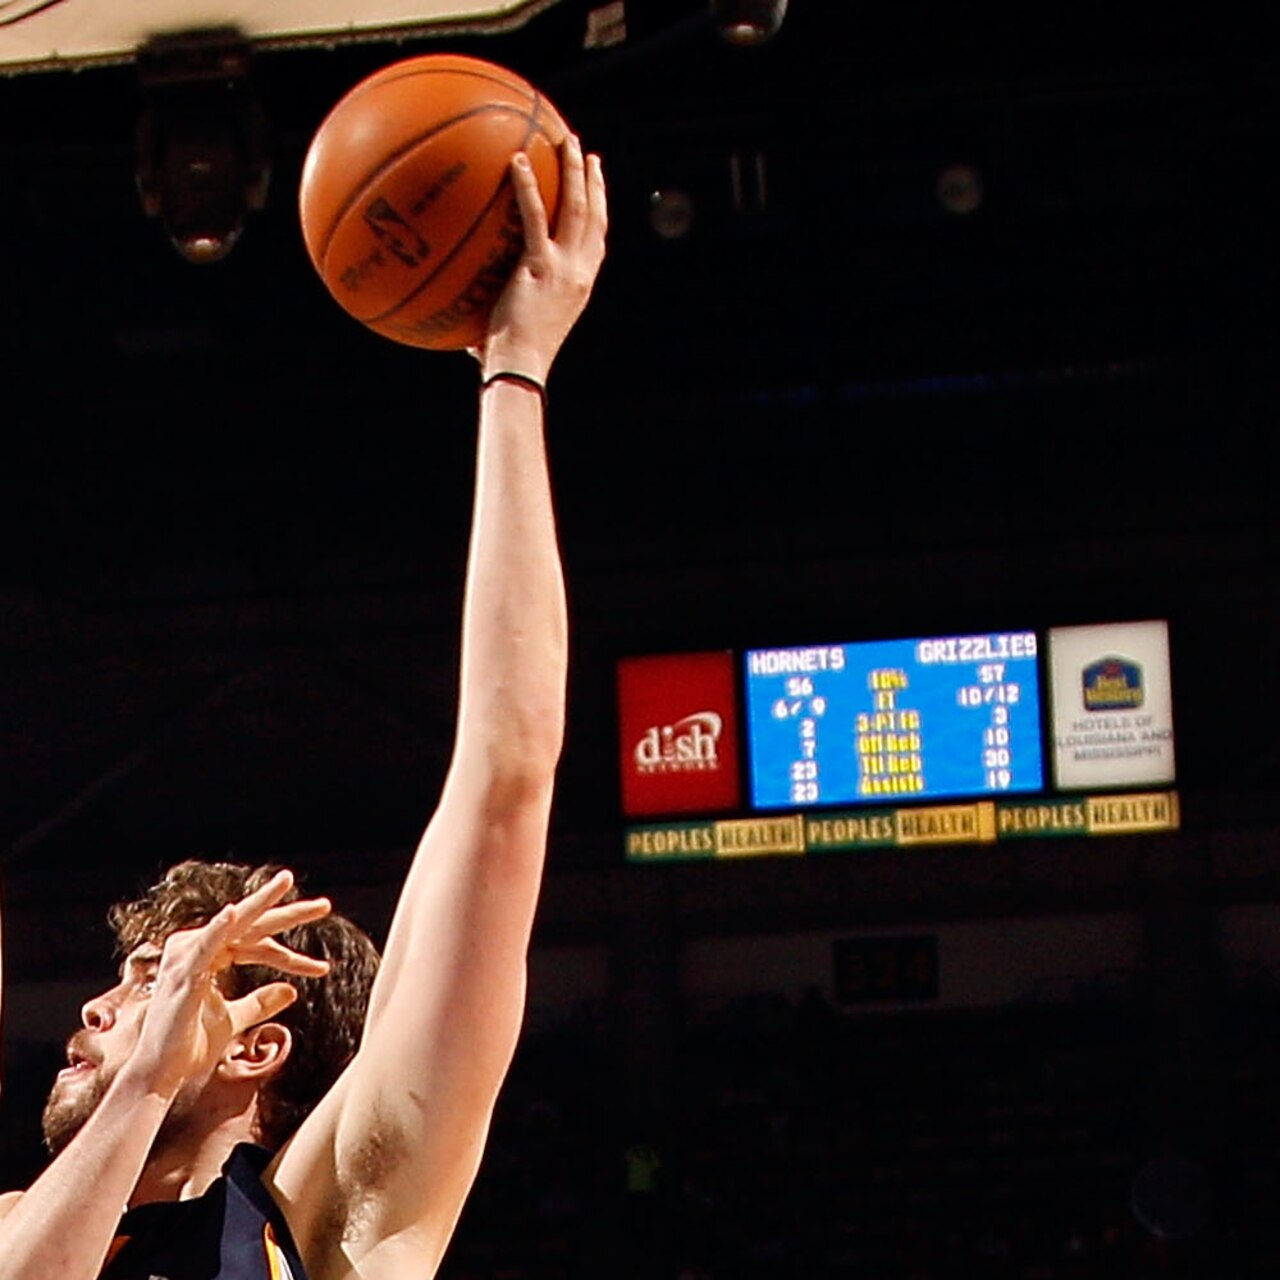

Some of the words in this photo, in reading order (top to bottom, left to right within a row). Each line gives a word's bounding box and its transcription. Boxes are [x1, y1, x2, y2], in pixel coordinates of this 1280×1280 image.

[751, 648, 844, 674] HORNETS
[919, 634, 1037, 663] GRIZZLIES
[786, 677, 814, 697] 56
[979, 664, 1006, 683] 57
[959, 684, 1019, 706] 10/12
[801, 718, 815, 738] 2
[995, 705, 1008, 724] 3
[635, 724, 719, 764] dish
[802, 739, 816, 759] 7
[986, 727, 1009, 746] 10
[792, 761, 817, 781] 23
[985, 749, 1009, 769] 30
[792, 782, 818, 802] 23
[987, 770, 1010, 789] 19
[629, 828, 713, 854] PEOPLES
[720, 820, 795, 848] HEALTH
[809, 816, 893, 843] PEOPLES
[900, 811, 975, 838] HEALTH
[1001, 804, 1085, 831] PEOPLES
[1093, 799, 1167, 824] HEALTH
